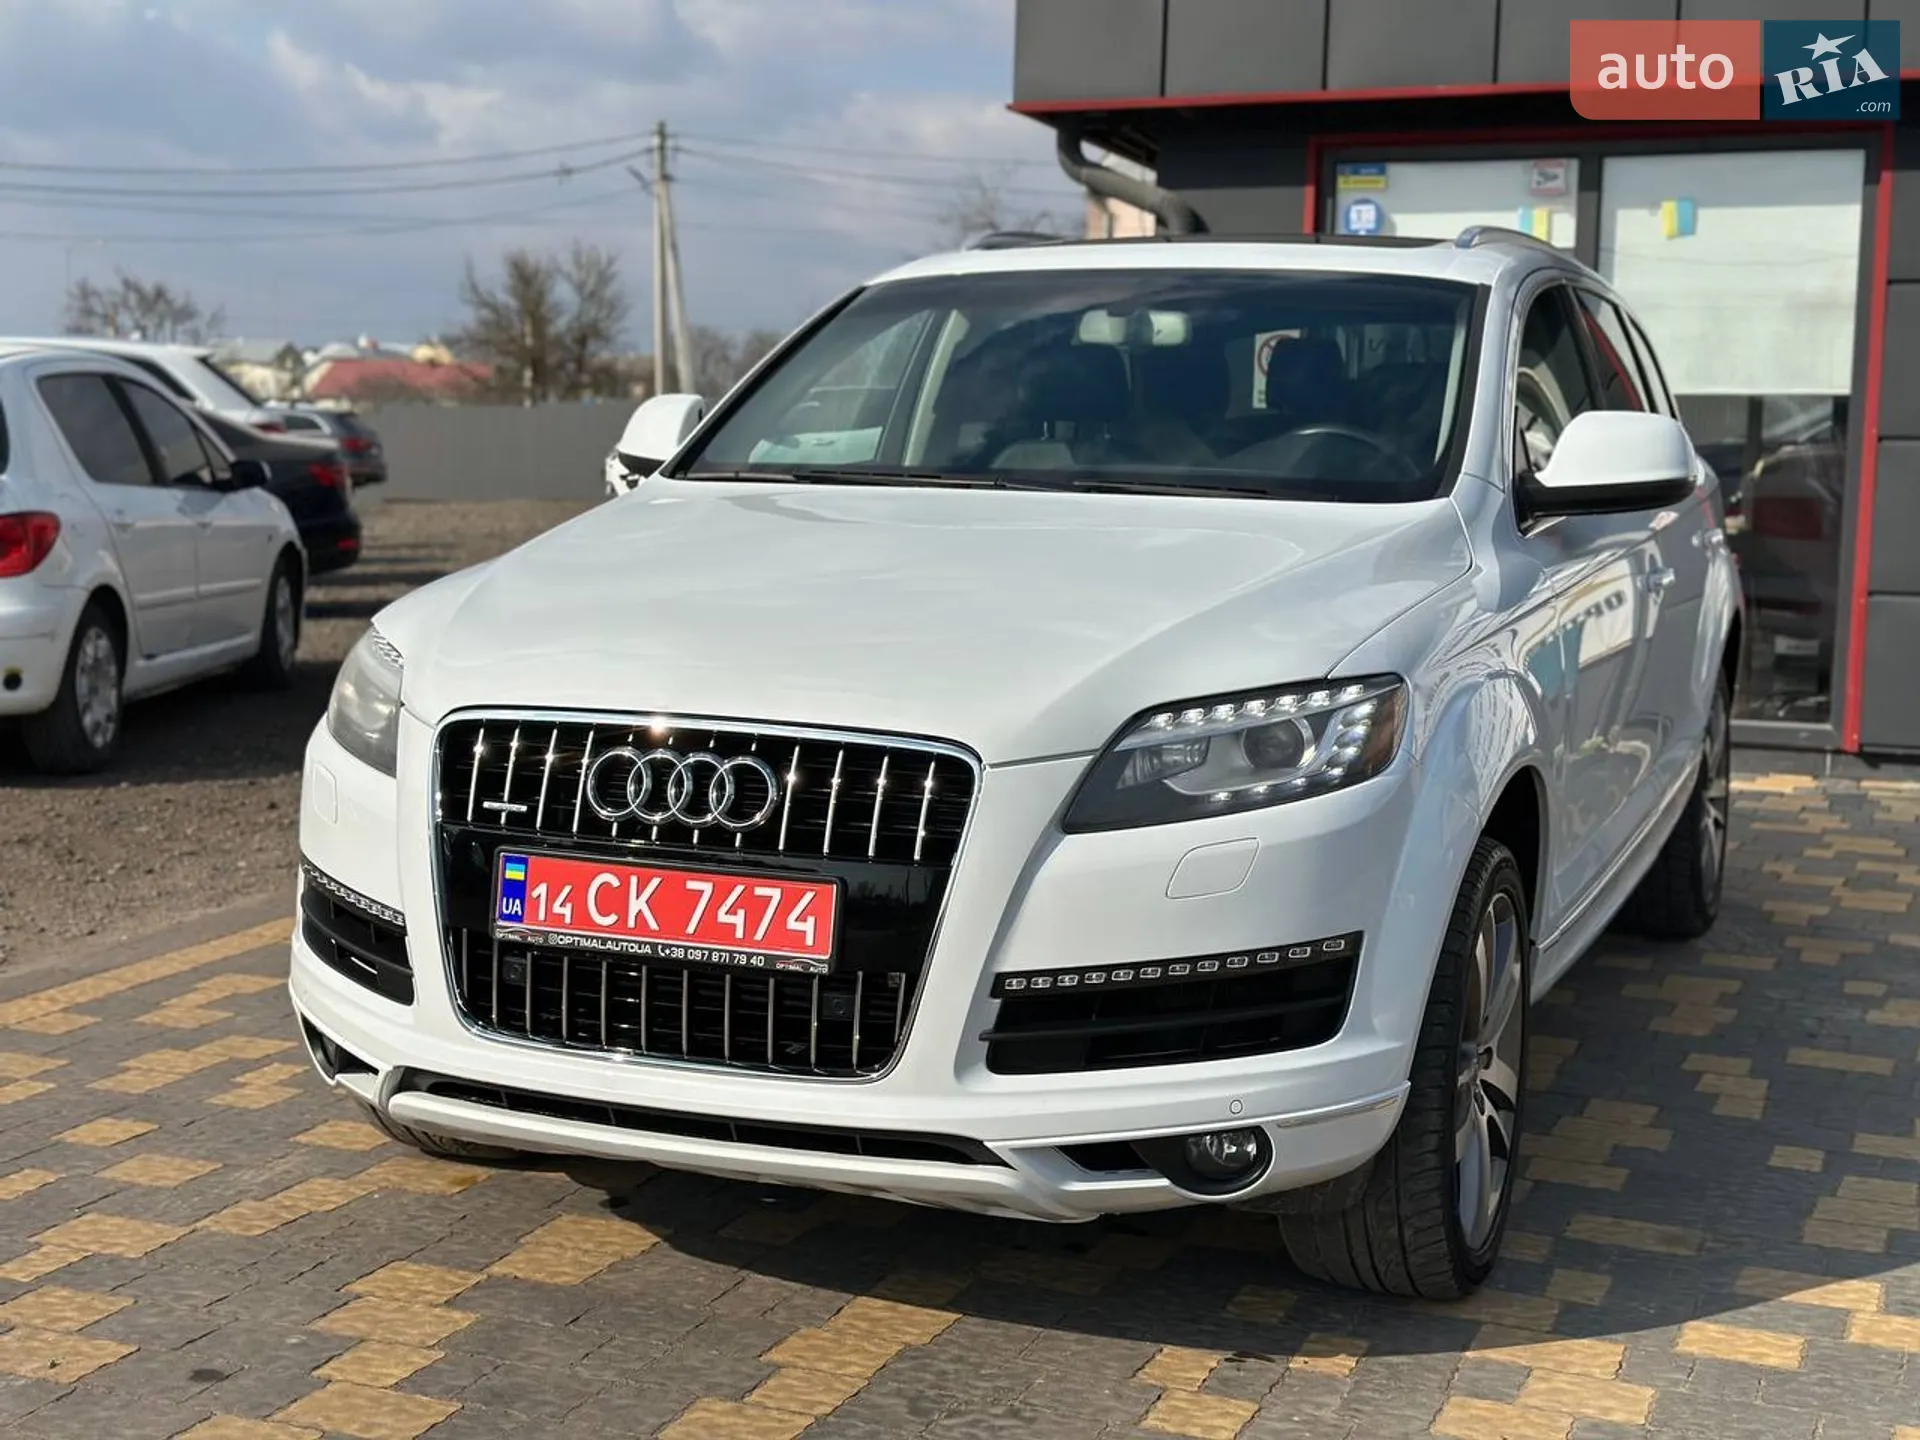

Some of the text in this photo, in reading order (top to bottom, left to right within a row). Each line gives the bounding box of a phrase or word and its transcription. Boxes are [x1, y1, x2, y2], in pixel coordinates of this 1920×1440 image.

[502, 896, 522, 917] UA
[531, 872, 817, 947] 14 CK 7474
[687, 948, 709, 961] 097
[711, 951, 730, 964] 871
[733, 954, 747, 965] 79
[750, 956, 765, 967] 40
